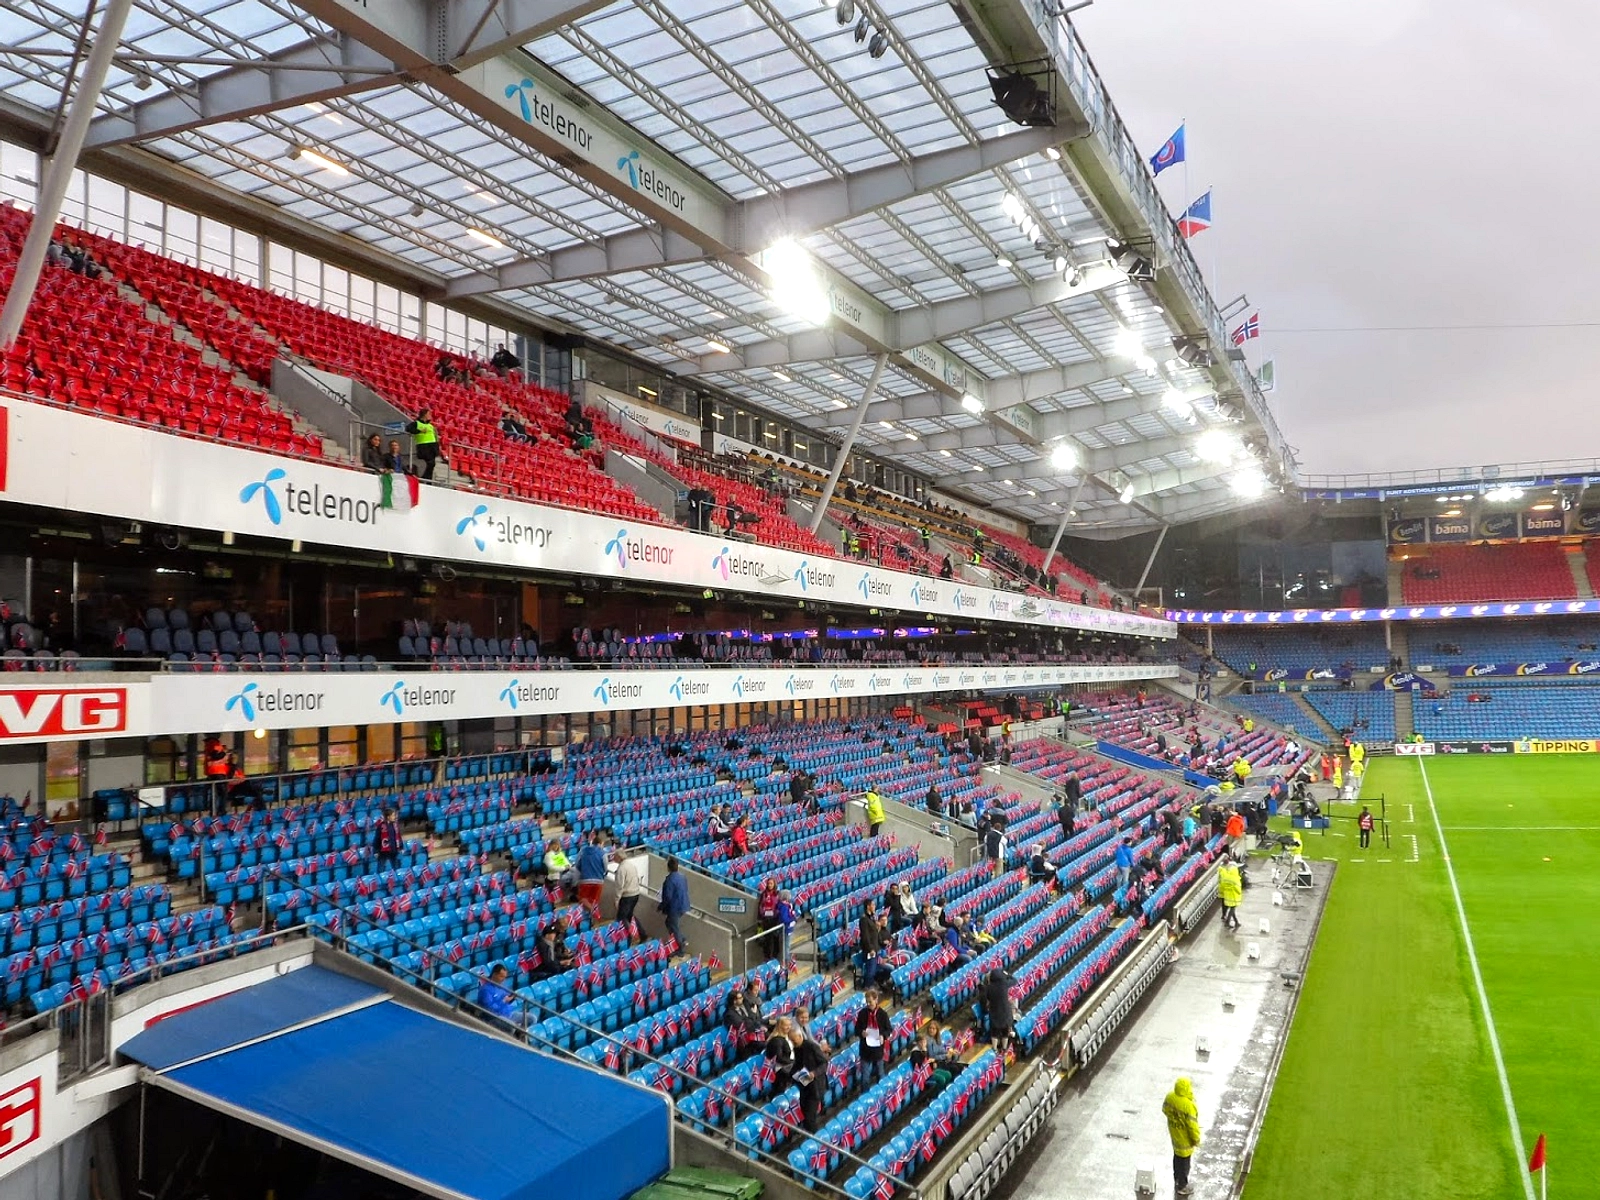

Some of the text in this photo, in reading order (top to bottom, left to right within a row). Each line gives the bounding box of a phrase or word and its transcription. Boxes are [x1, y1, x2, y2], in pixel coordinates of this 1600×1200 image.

[532, 94, 592, 151] telenor
[638, 163, 686, 211] telenor
[834, 293, 862, 323] telenor
[284, 481, 382, 525] telenor
[486, 516, 553, 548] telenor
[1435, 523, 1469, 535] bama
[1527, 519, 1561, 530] bama
[626, 537, 674, 566] telenor
[728, 554, 765, 578] telenor
[806, 567, 836, 588] telenor
[868, 577, 892, 596] telenor
[919, 586, 939, 602] telenor
[1473, 663, 1497, 676] Bendit
[1524, 662, 1548, 675] Bendit
[681, 679, 710, 695] telenor
[742, 678, 766, 692] telenor
[793, 677, 814, 690] telenor
[836, 676, 856, 689] telenor
[1391, 672, 1415, 686] Bendit
[403, 685, 456, 707] telenor
[517, 683, 560, 702] telenor
[608, 681, 643, 699] telenor
[256, 688, 324, 712] telenor
[0, 692, 119, 734] VG
[1397, 744, 1433, 754] VG
[1532, 741, 1590, 752] TIPPING
